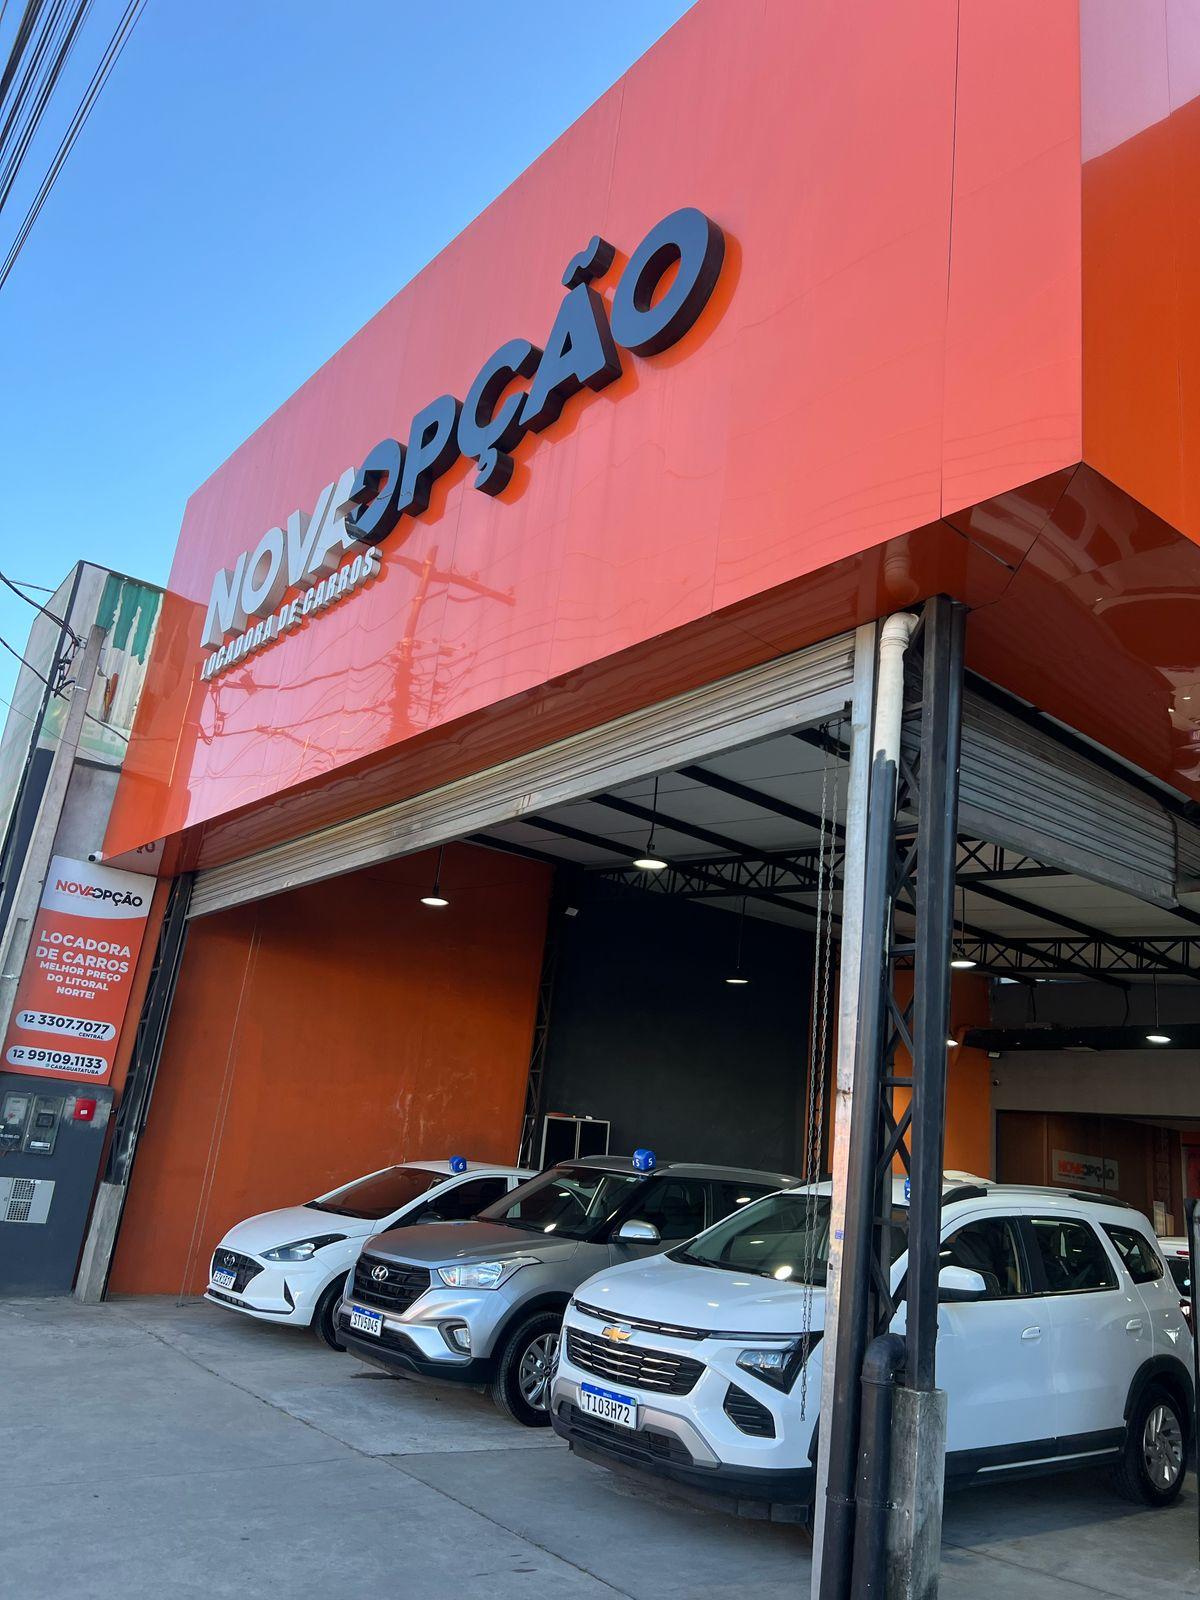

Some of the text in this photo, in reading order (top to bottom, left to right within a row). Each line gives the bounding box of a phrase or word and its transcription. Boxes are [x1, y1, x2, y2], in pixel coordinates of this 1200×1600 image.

[200, 546, 383, 682] LOCADORA DE CARROS
[40, 930, 131, 958] LOCADORA
[35, 945, 129, 974] DE CARROS
[39, 960, 122, 982] MELHOR PREÇO
[46, 973, 109, 991] DO LITORAL
[56, 986, 96, 1000] NORTE!
[23, 1013, 110, 1035] 12 3307.7077
[78, 1032, 105, 1040] CENTRAL
[12, 1048, 103, 1069] 12 99109.1133
[50, 1064, 100, 1075] CARAGUATATUBA
